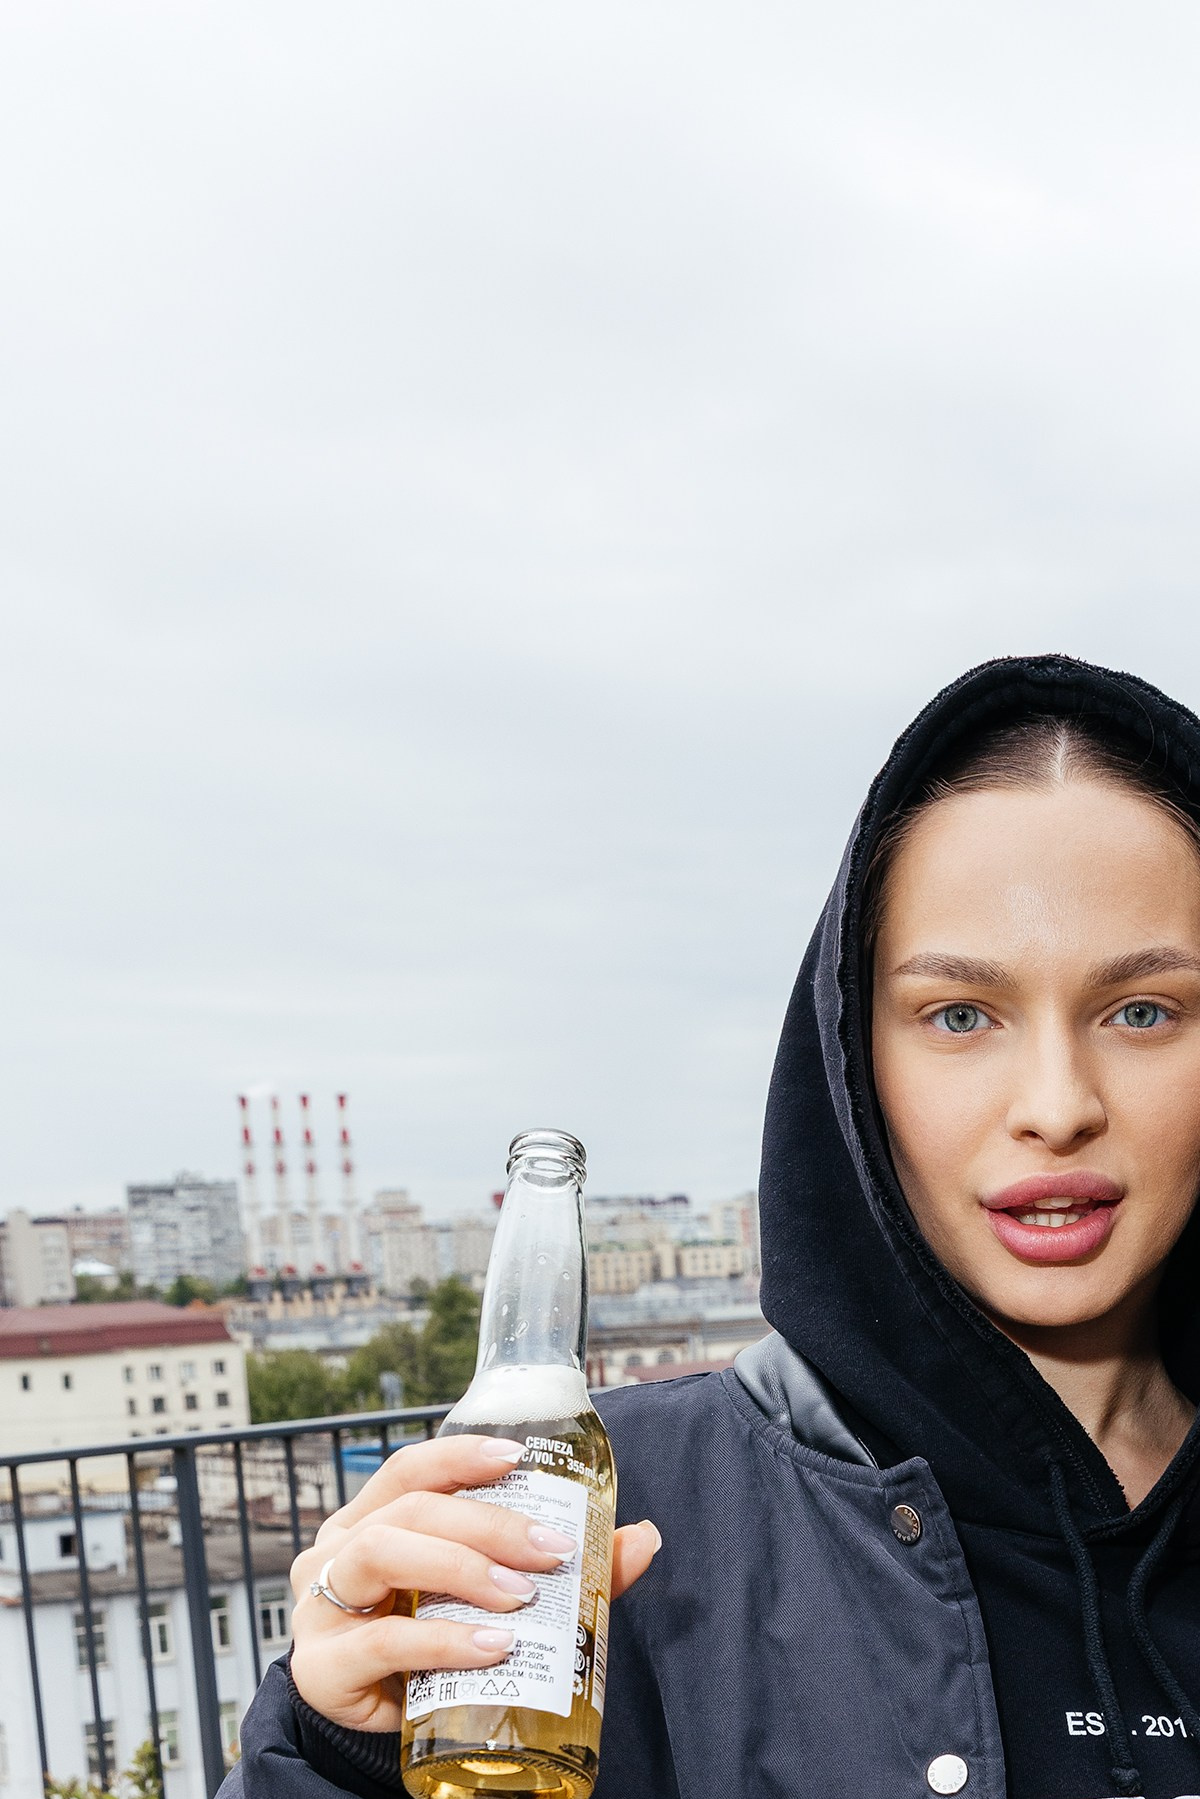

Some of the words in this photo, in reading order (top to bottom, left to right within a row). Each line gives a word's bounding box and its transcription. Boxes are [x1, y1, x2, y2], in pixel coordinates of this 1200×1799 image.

[525, 1435, 574, 1457] CERVEZA
[498, 1483, 530, 1492] ЭКСТРА
[503, 1491, 572, 1509] ФИЛЬТРОВАННЫЙ
[516, 1640, 558, 1654] ДОРОВЬЮ.
[513, 1659, 551, 1672] БУТЫЛКЕ
[528, 1673, 548, 1683] 0.355
[1065, 1711, 1138, 1736] ES.
[1141, 1714, 1195, 1738] 201
